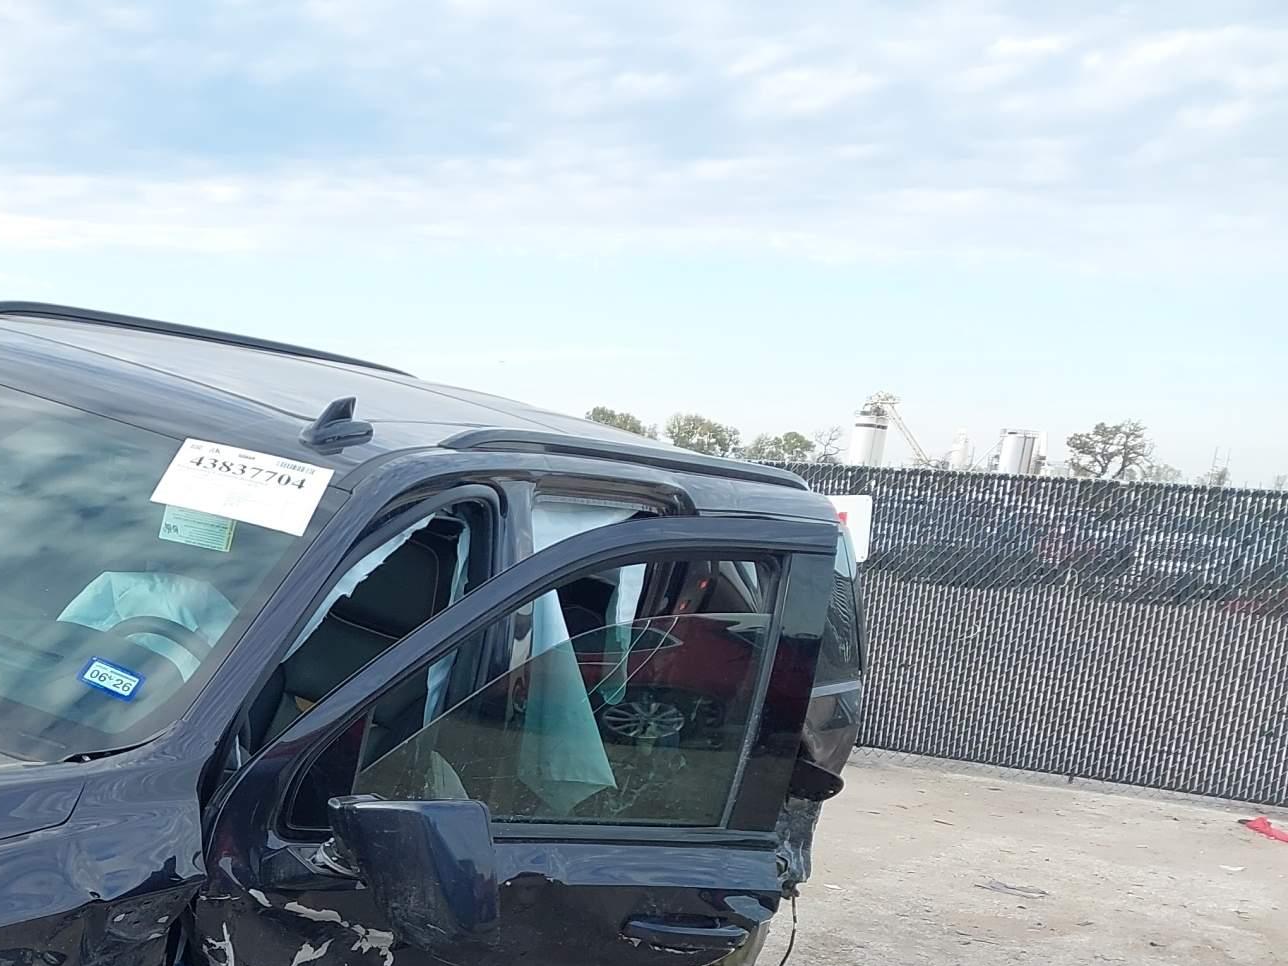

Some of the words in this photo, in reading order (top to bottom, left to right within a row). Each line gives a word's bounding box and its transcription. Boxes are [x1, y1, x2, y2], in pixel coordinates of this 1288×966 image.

[189, 455, 307, 490] 43837704
[90, 669, 108, 683] 06
[112, 678, 133, 692] 26
